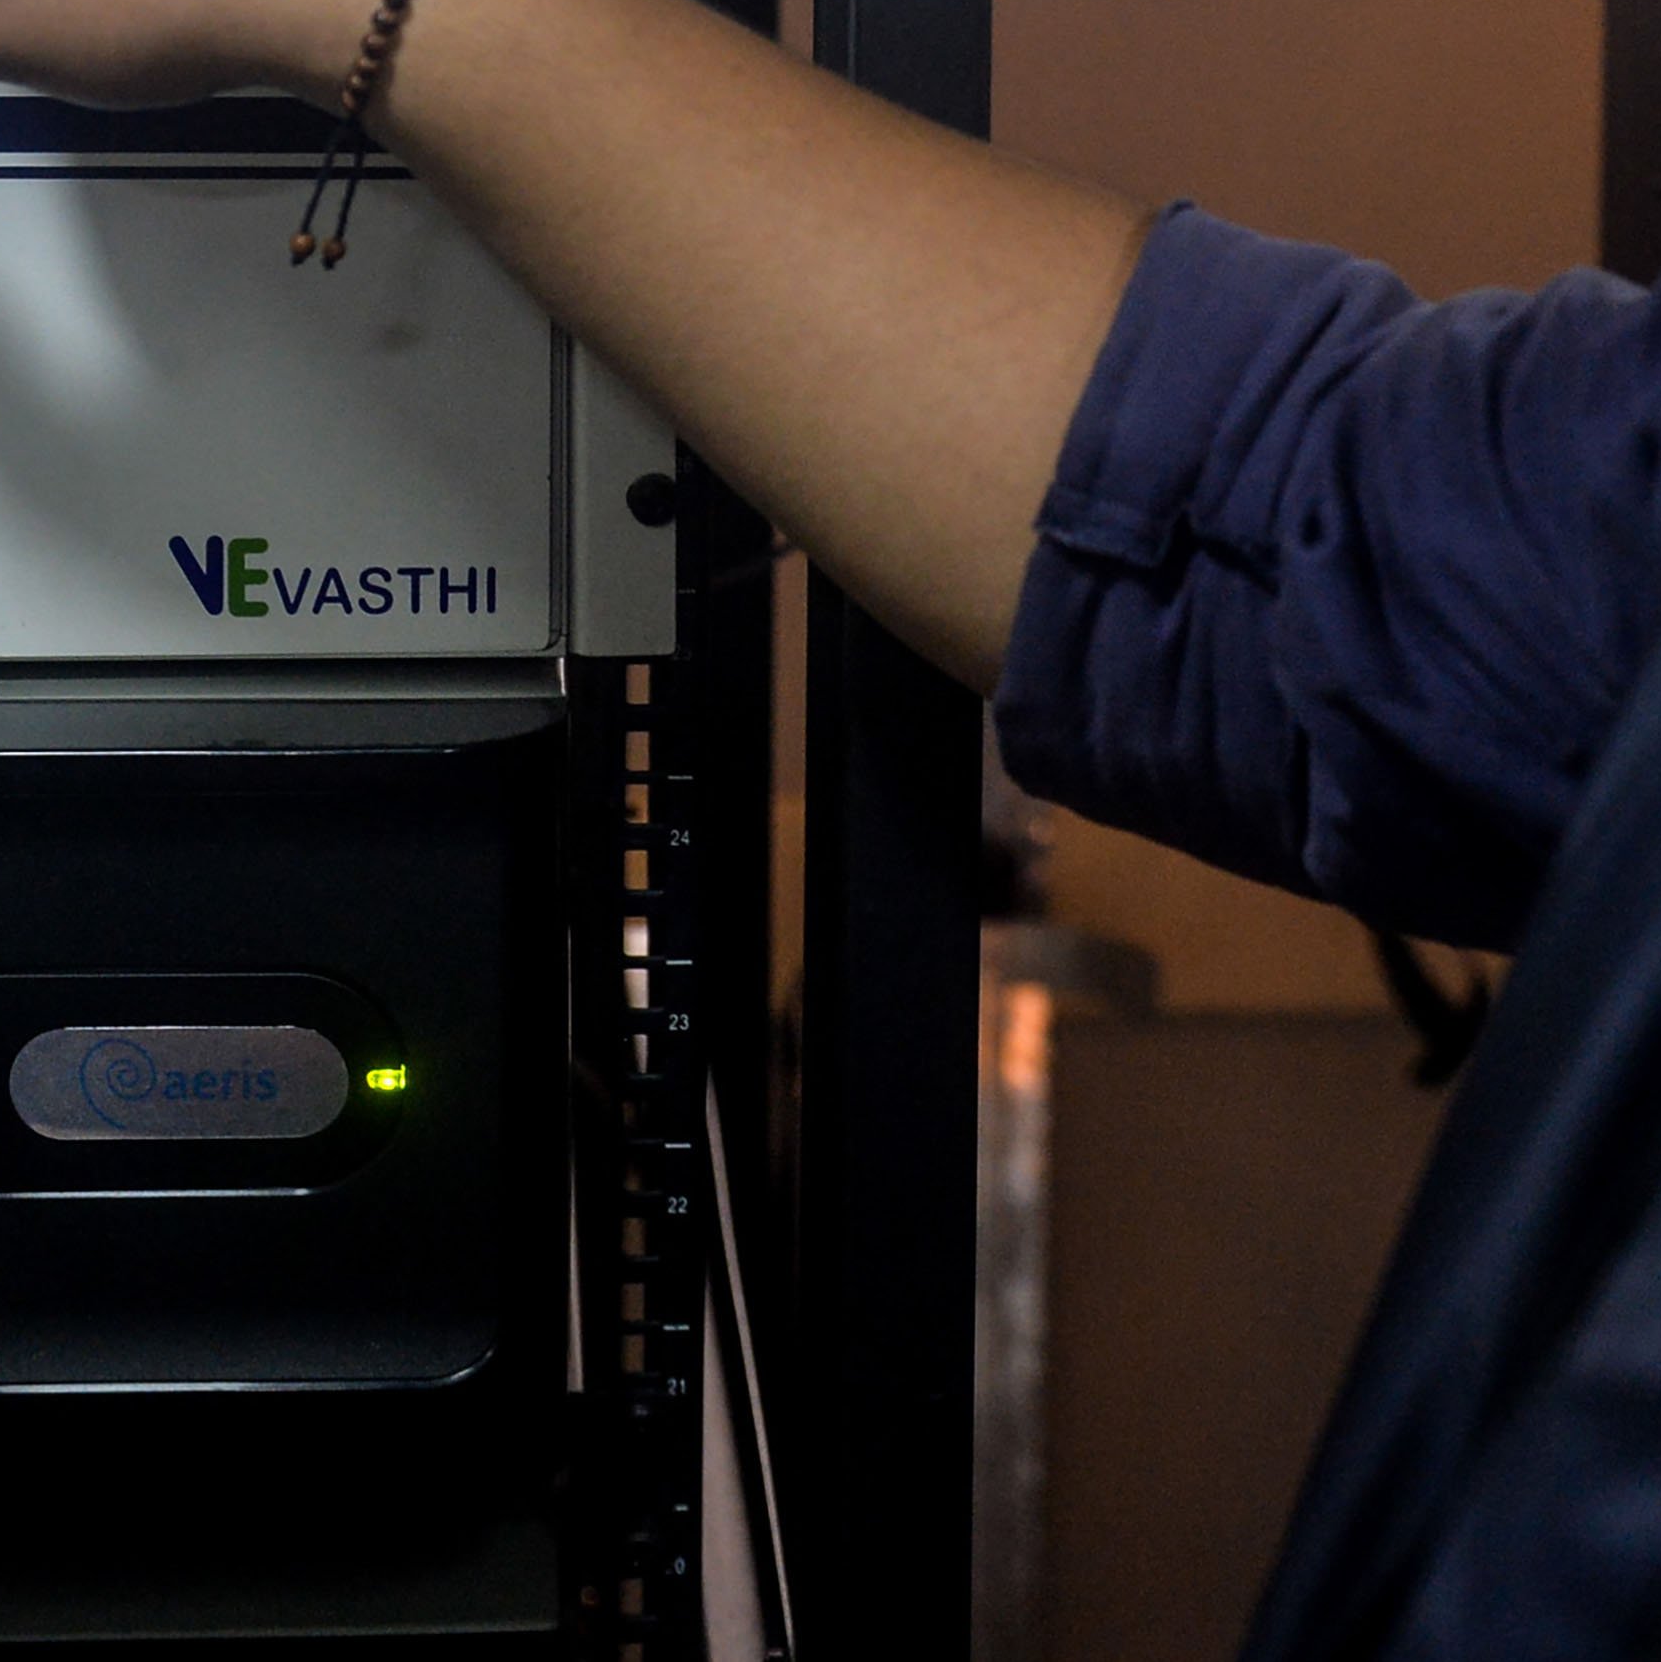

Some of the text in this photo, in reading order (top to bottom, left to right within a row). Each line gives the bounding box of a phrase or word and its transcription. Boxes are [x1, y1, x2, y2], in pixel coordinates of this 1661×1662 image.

[669, 829, 691, 846] 24
[668, 1013, 690, 1030] 23
[161, 1060, 280, 1102] aeris
[667, 1196, 689, 1213] 22
[667, 1378, 686, 1396] 21
